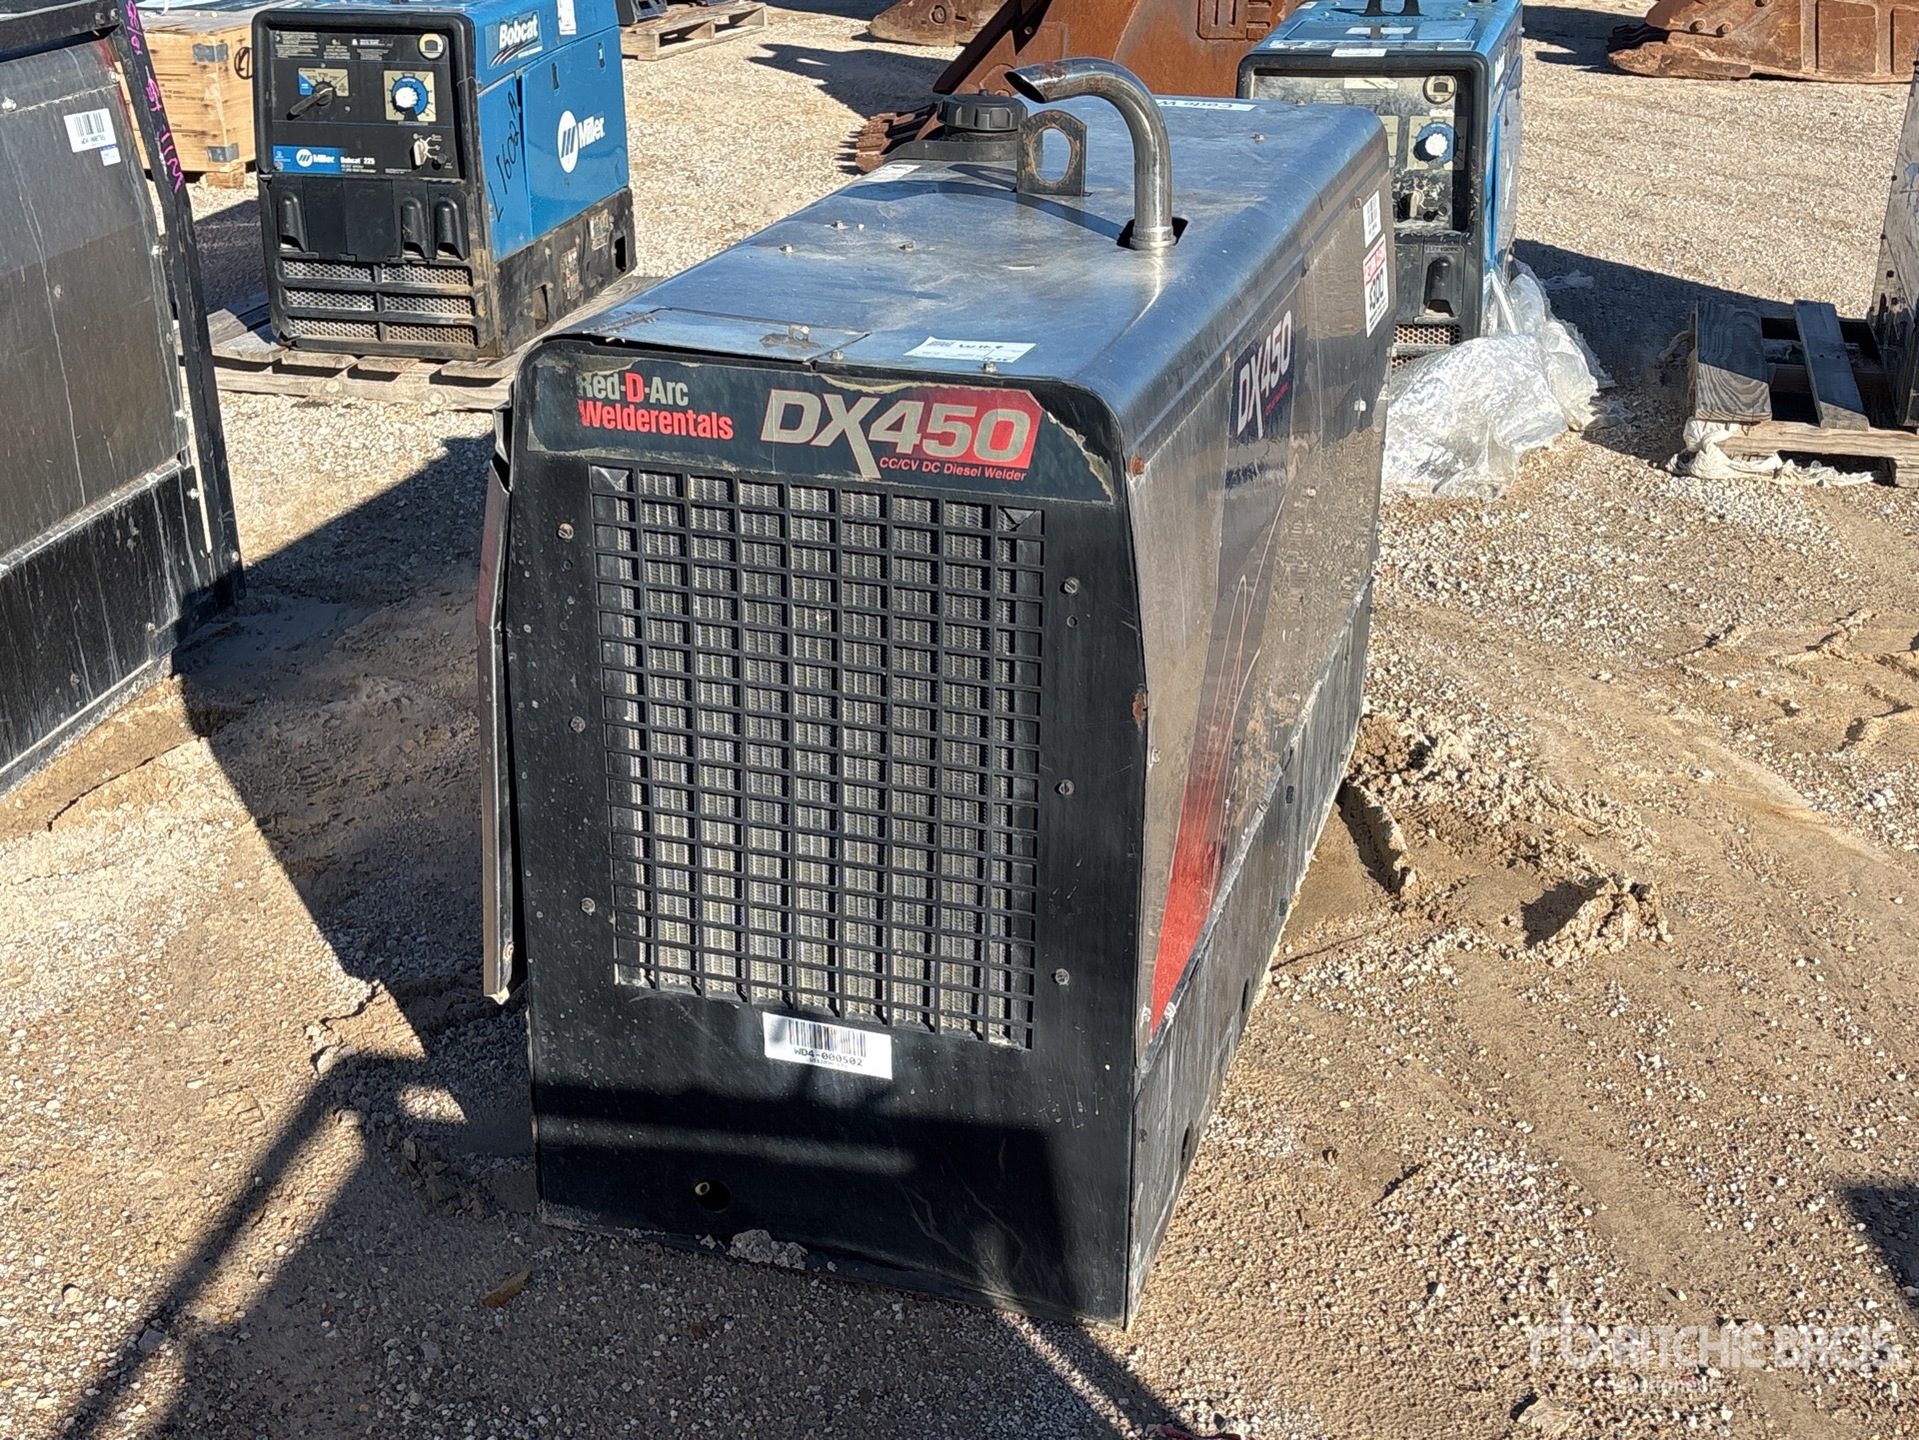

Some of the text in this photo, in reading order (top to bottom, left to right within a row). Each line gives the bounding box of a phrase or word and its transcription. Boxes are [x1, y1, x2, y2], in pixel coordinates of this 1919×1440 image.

[499, 13, 538, 49] Bobcat
[578, 116, 606, 149] Miller
[312, 153, 336, 164] Miller
[340, 156, 361, 164] Bobcat
[1237, 309, 1292, 440] DX450
[577, 399, 735, 441] Welderentals
[760, 388, 1032, 479] DX450
[879, 456, 1028, 482] CC/CV DC Diesel Welder
